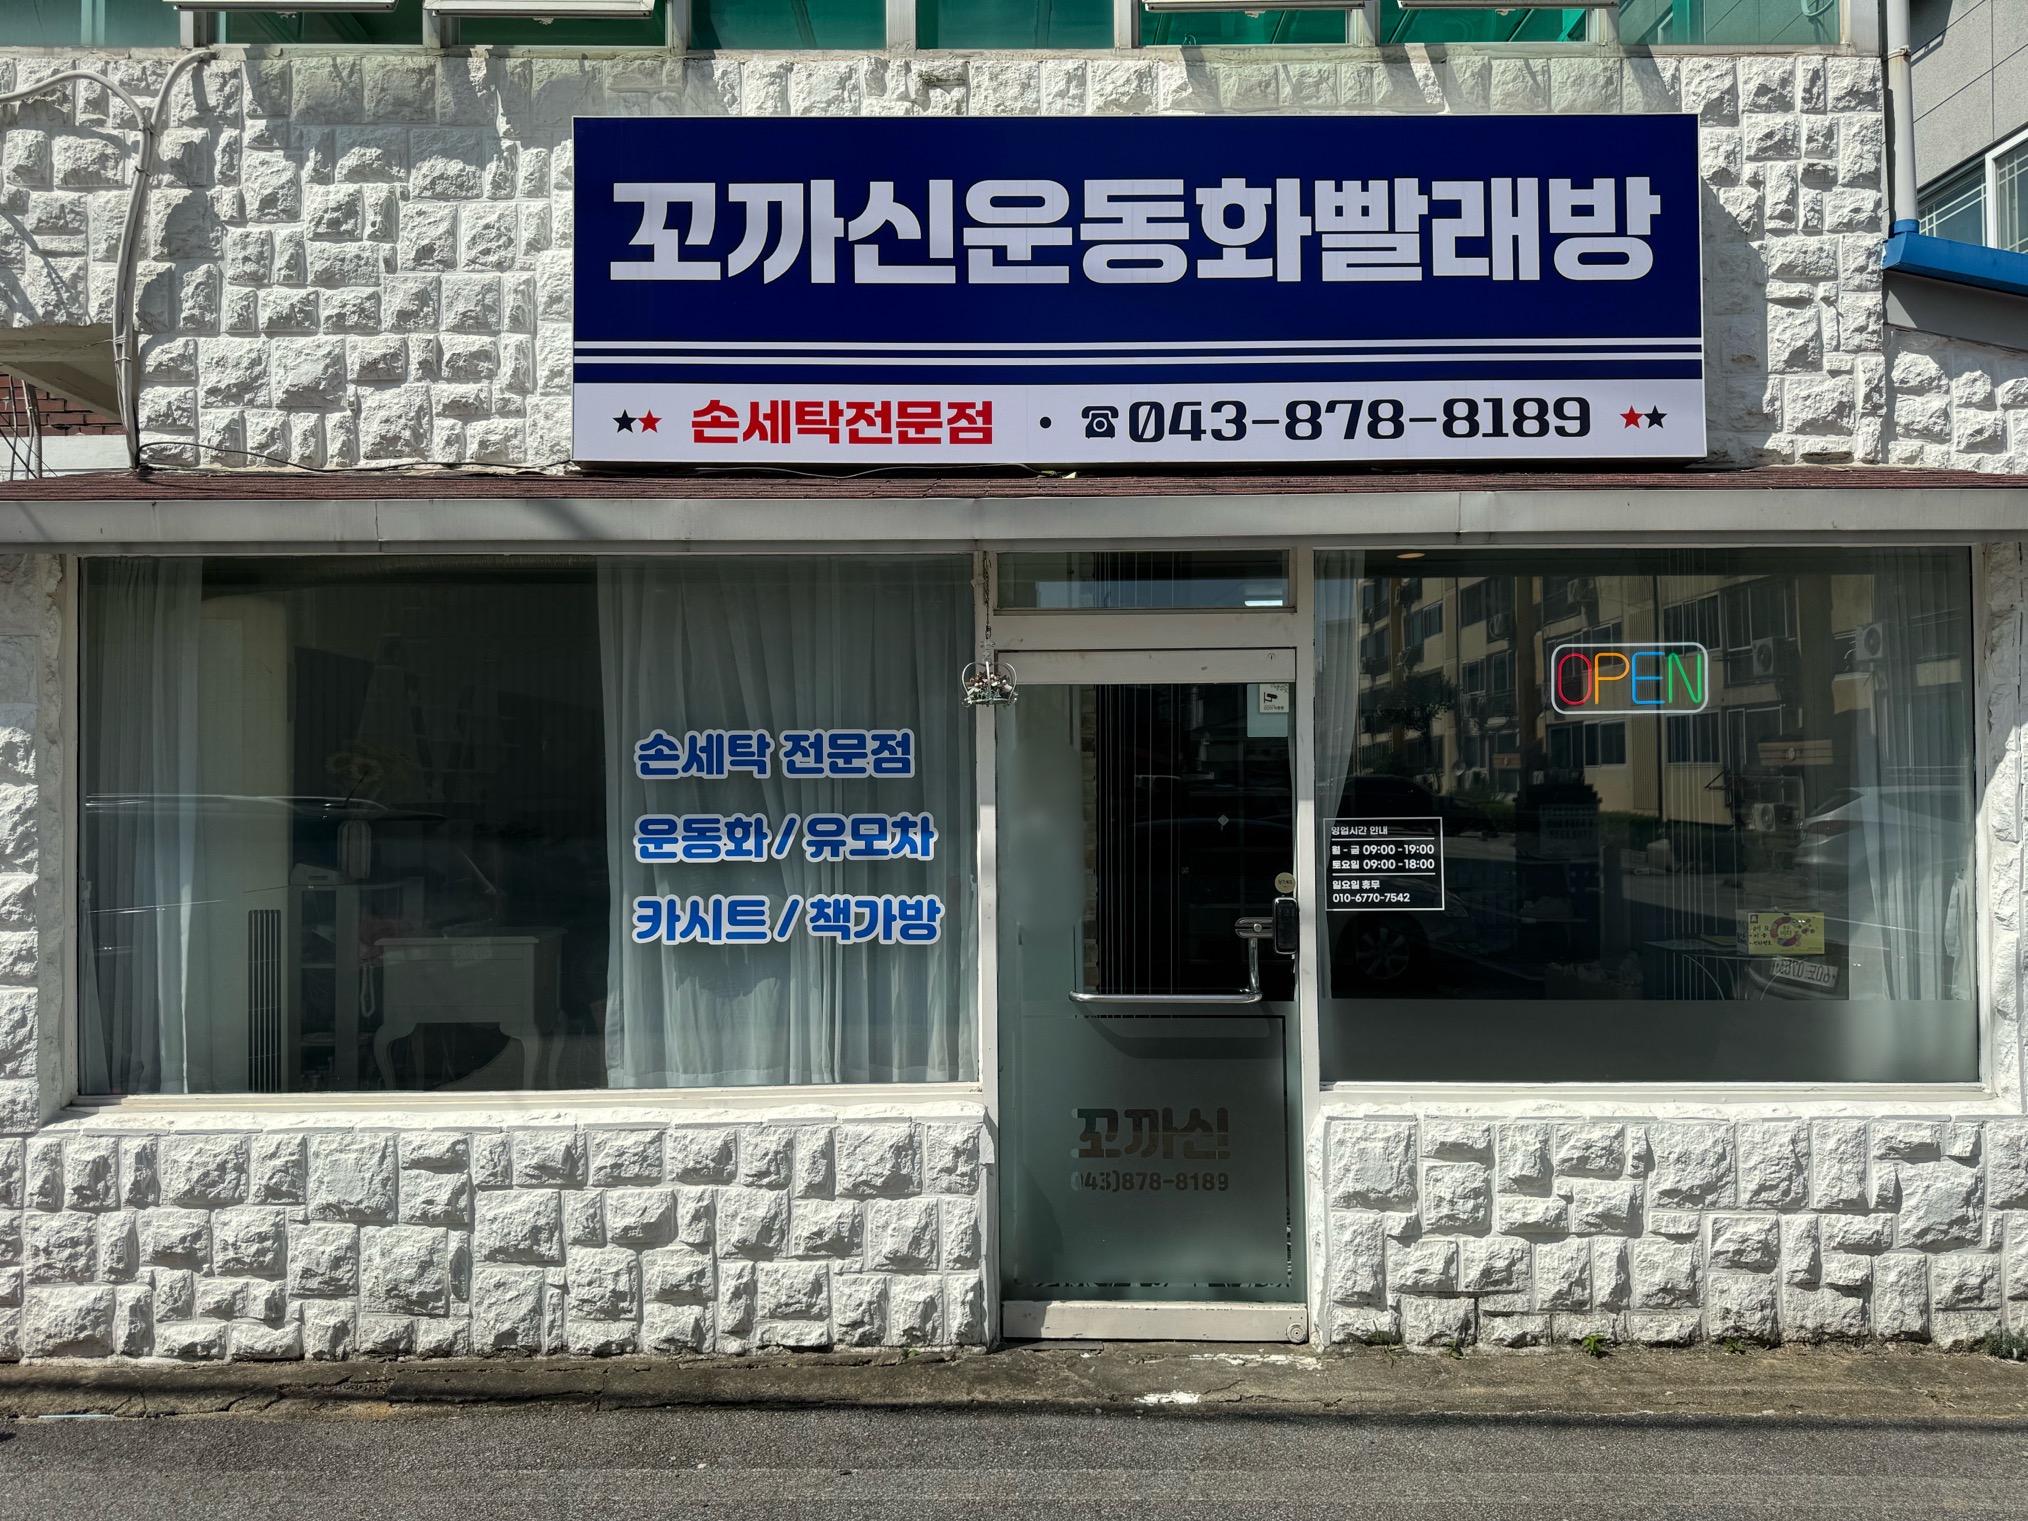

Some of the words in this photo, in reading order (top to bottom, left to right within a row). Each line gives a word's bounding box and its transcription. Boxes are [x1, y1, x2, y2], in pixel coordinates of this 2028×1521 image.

[610, 176, 1662, 285] 꼬까신운동화빨래방
[691, 399, 993, 445] 손세탁전문점
[1129, 396, 1591, 443] 043-878-8189
[1557, 651, 1703, 706] OPEN
[634, 729, 774, 779] 손세탁
[780, 728, 915, 779] 전문점
[1331, 826, 1367, 836] 영업시간
[1369, 826, 1388, 836] 안내
[1332, 860, 1360, 869] 토요일
[1332, 880, 1360, 890] 일요일
[1361, 880, 1381, 890] 휴무
[1332, 892, 1410, 903] 010-6770-7542
[1071, 1107, 1231, 1160] 꼬까신
